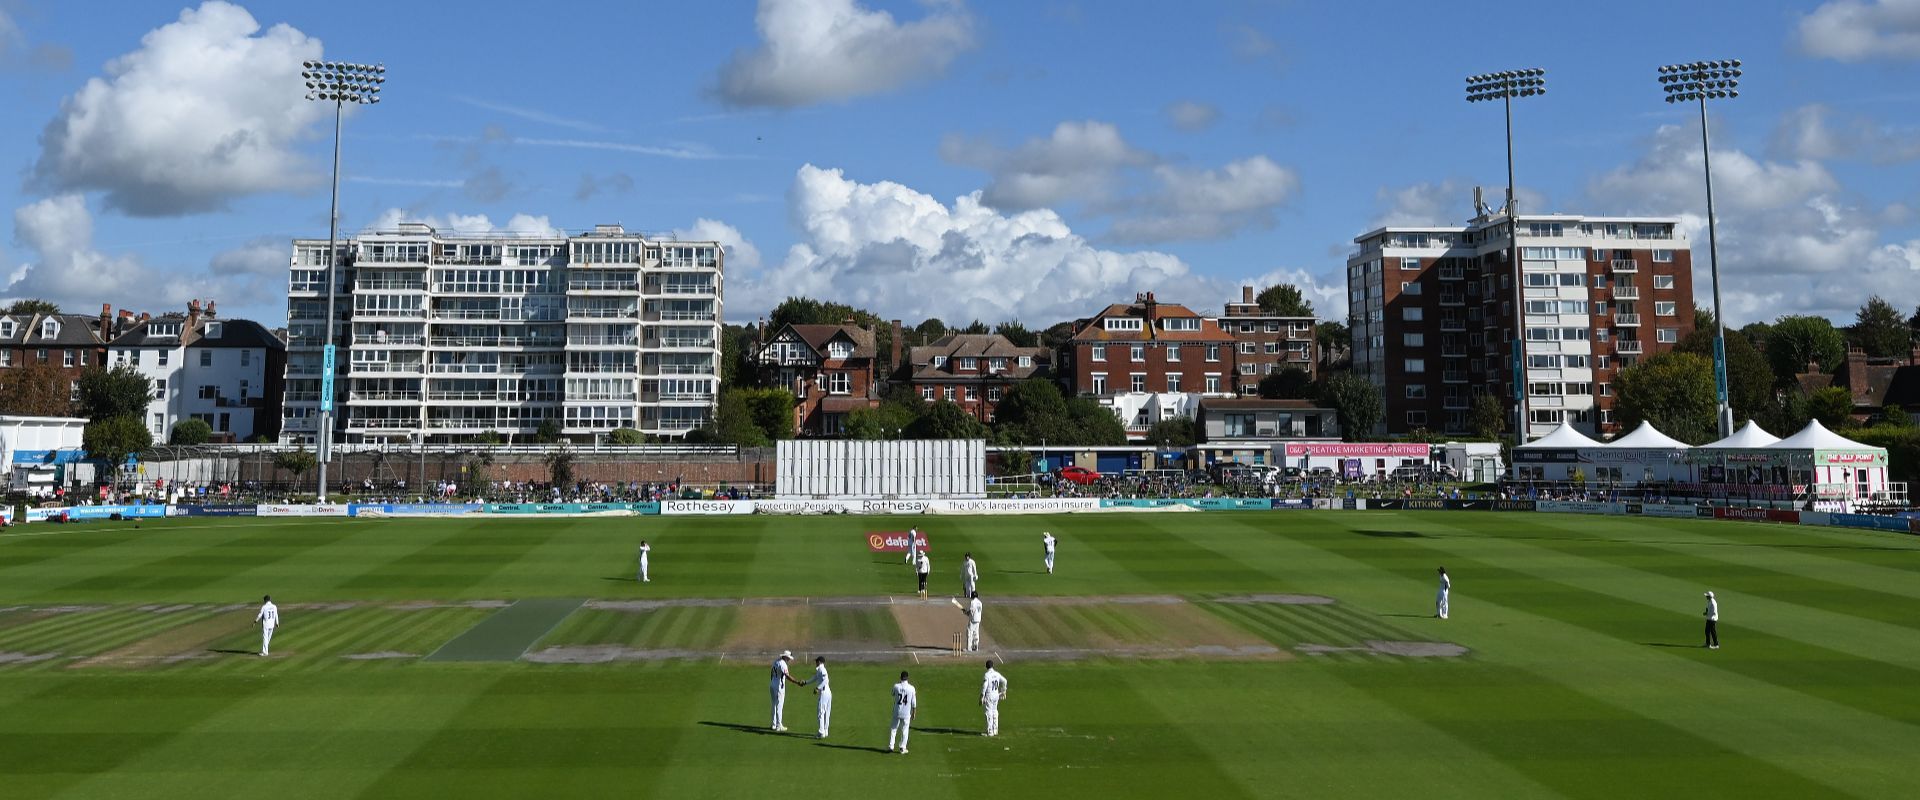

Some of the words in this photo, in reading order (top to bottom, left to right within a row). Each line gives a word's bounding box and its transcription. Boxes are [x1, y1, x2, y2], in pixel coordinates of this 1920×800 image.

[1343, 446, 1387, 454] MARKETING
[1388, 446, 1427, 454] PARTNERS
[667, 501, 735, 513] Rothesay
[754, 502, 800, 511] Protecting
[804, 502, 845, 511] Pensions
[863, 500, 930, 511] Rothesay
[948, 501, 965, 510] The
[967, 501, 987, 510] UK's
[989, 501, 1020, 511] largest
[1023, 501, 1059, 510] pension
[1061, 501, 1094, 509] insurer
[1724, 507, 1767, 518] LanGuard
[885, 536, 927, 548] dafaet
[898, 693, 908, 706] 24
